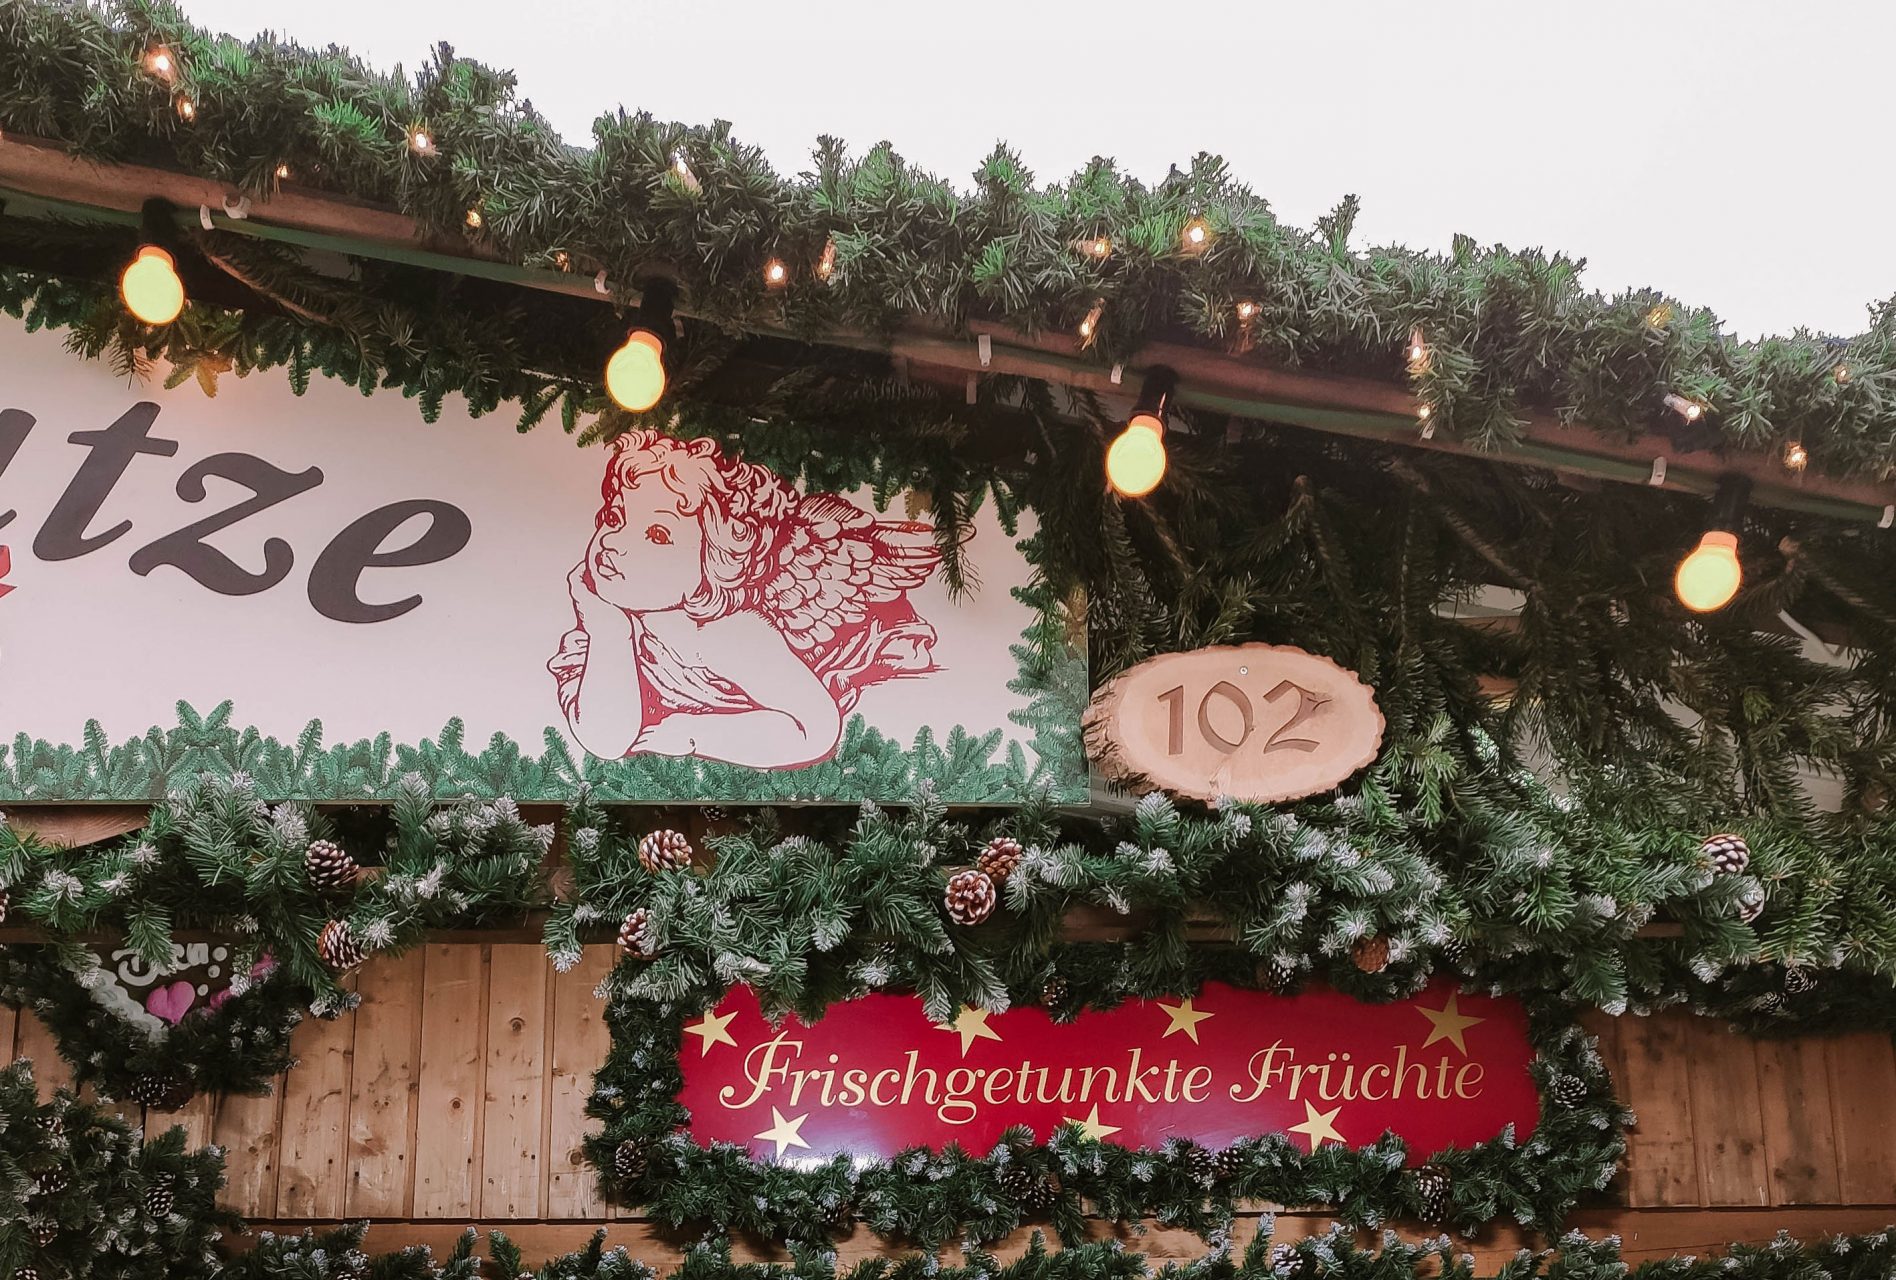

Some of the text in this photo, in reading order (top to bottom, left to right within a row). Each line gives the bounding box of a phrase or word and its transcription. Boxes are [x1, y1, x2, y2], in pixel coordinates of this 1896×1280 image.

[0, 401, 472, 623] tze
[1158, 680, 1320, 755] 102
[719, 1030, 1484, 1124] Frischgetunkte Früchte
